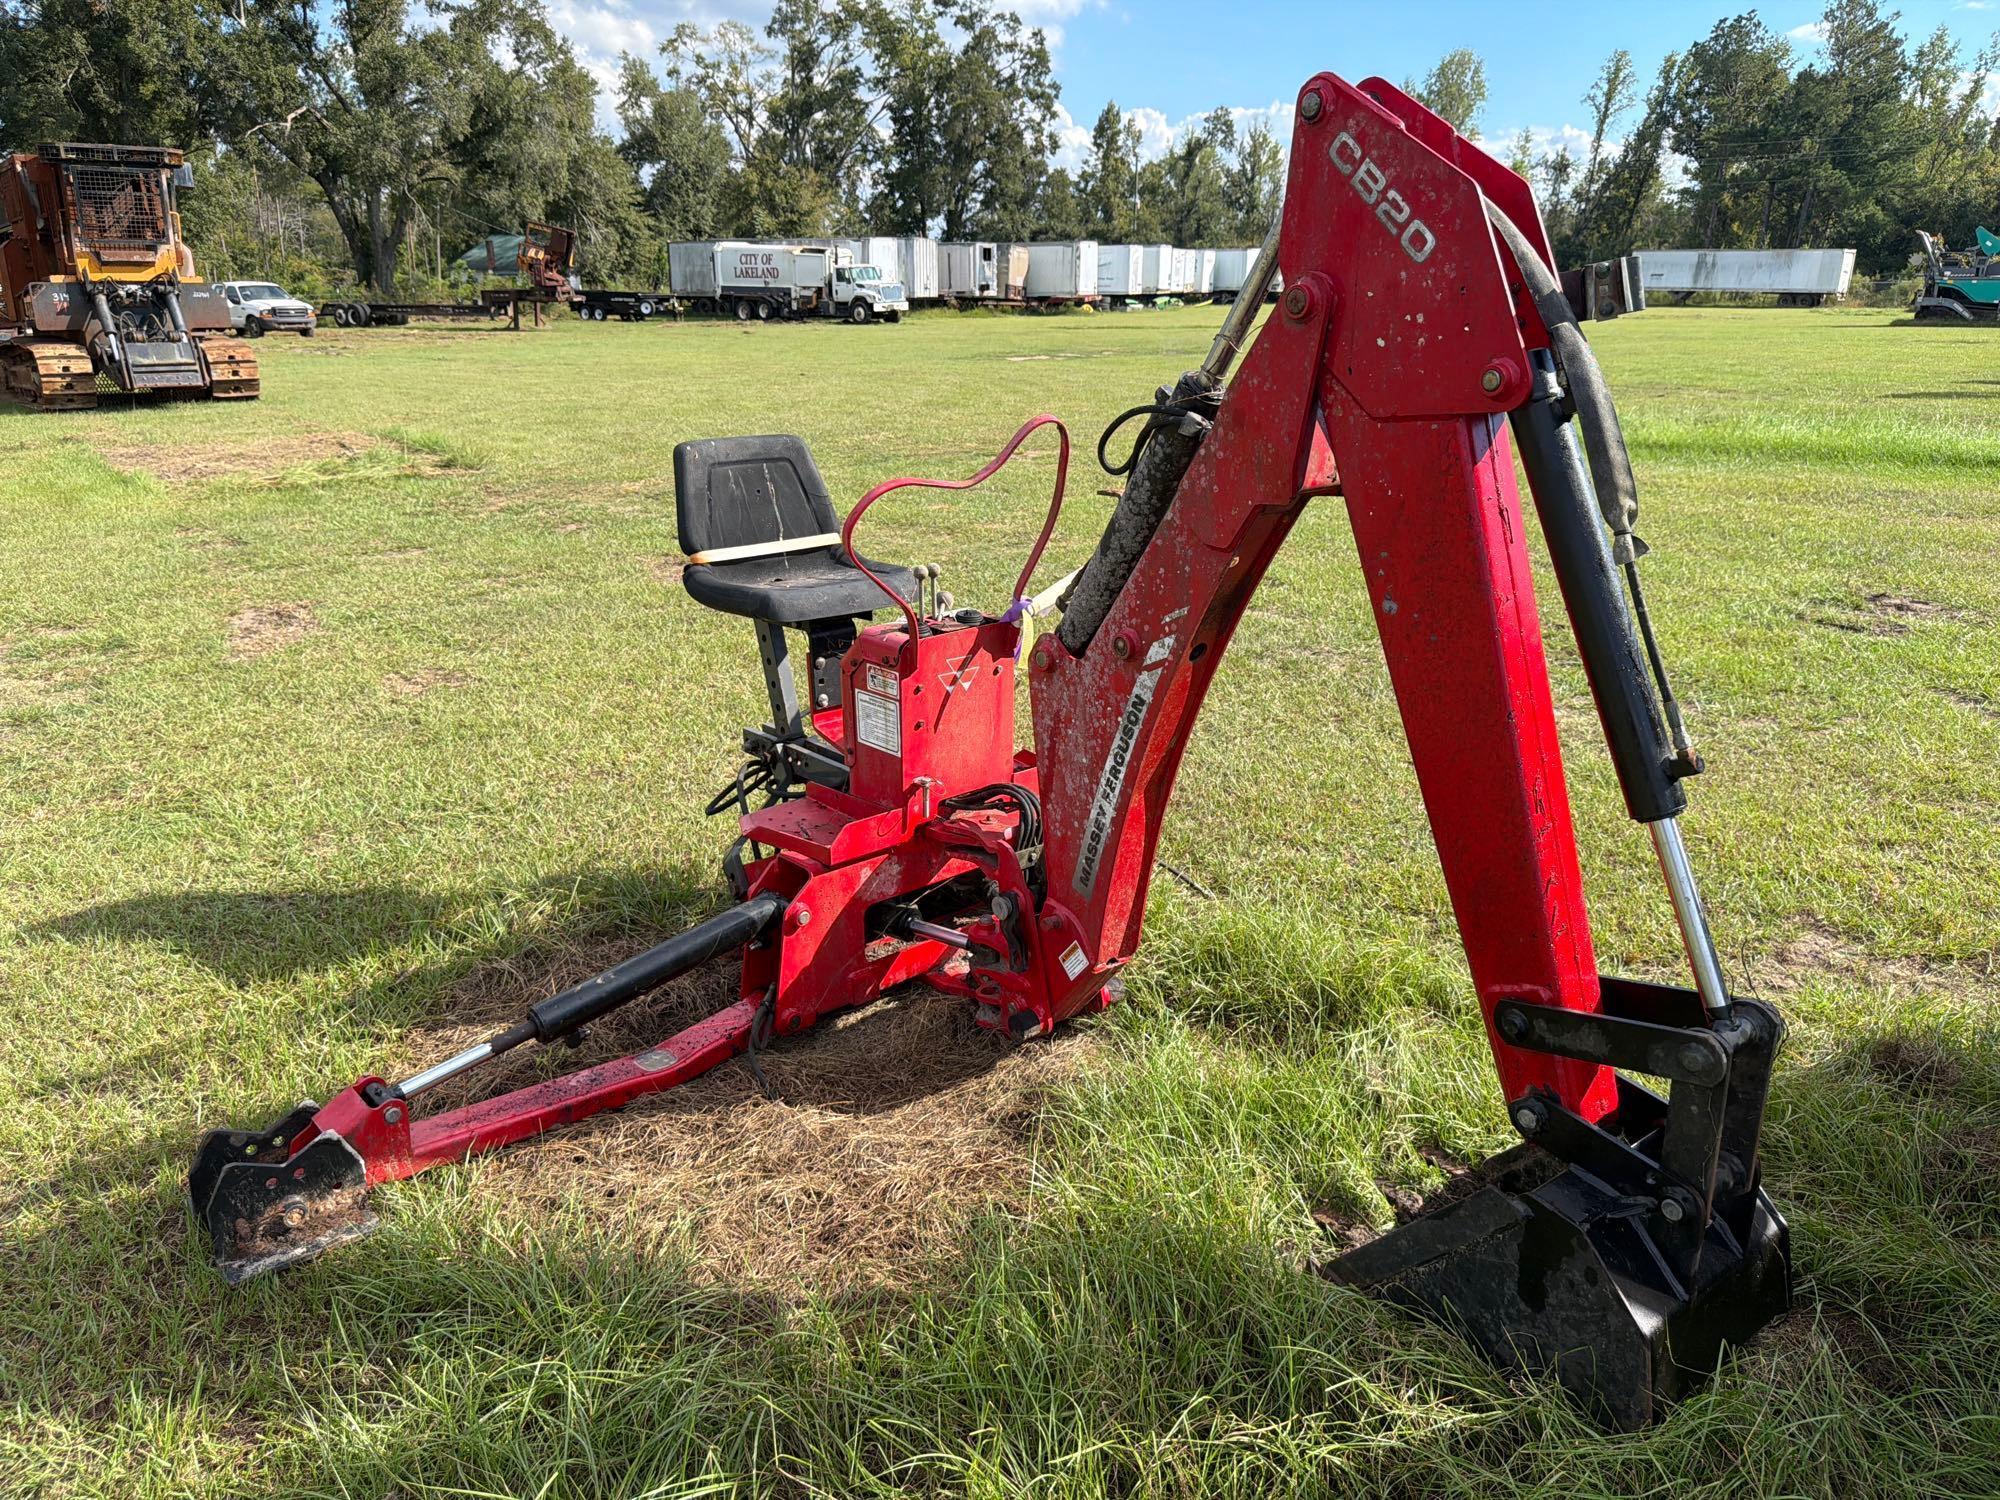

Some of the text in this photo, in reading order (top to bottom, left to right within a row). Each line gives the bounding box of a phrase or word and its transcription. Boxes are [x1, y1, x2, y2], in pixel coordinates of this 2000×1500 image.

[1328, 131, 1436, 263] CB20
[739, 253, 774, 265] CITY OF
[734, 267, 779, 279] LAKELAND
[52, 292, 70, 302] 314
[1079, 693, 1146, 889] MASSEY FERGUSON
